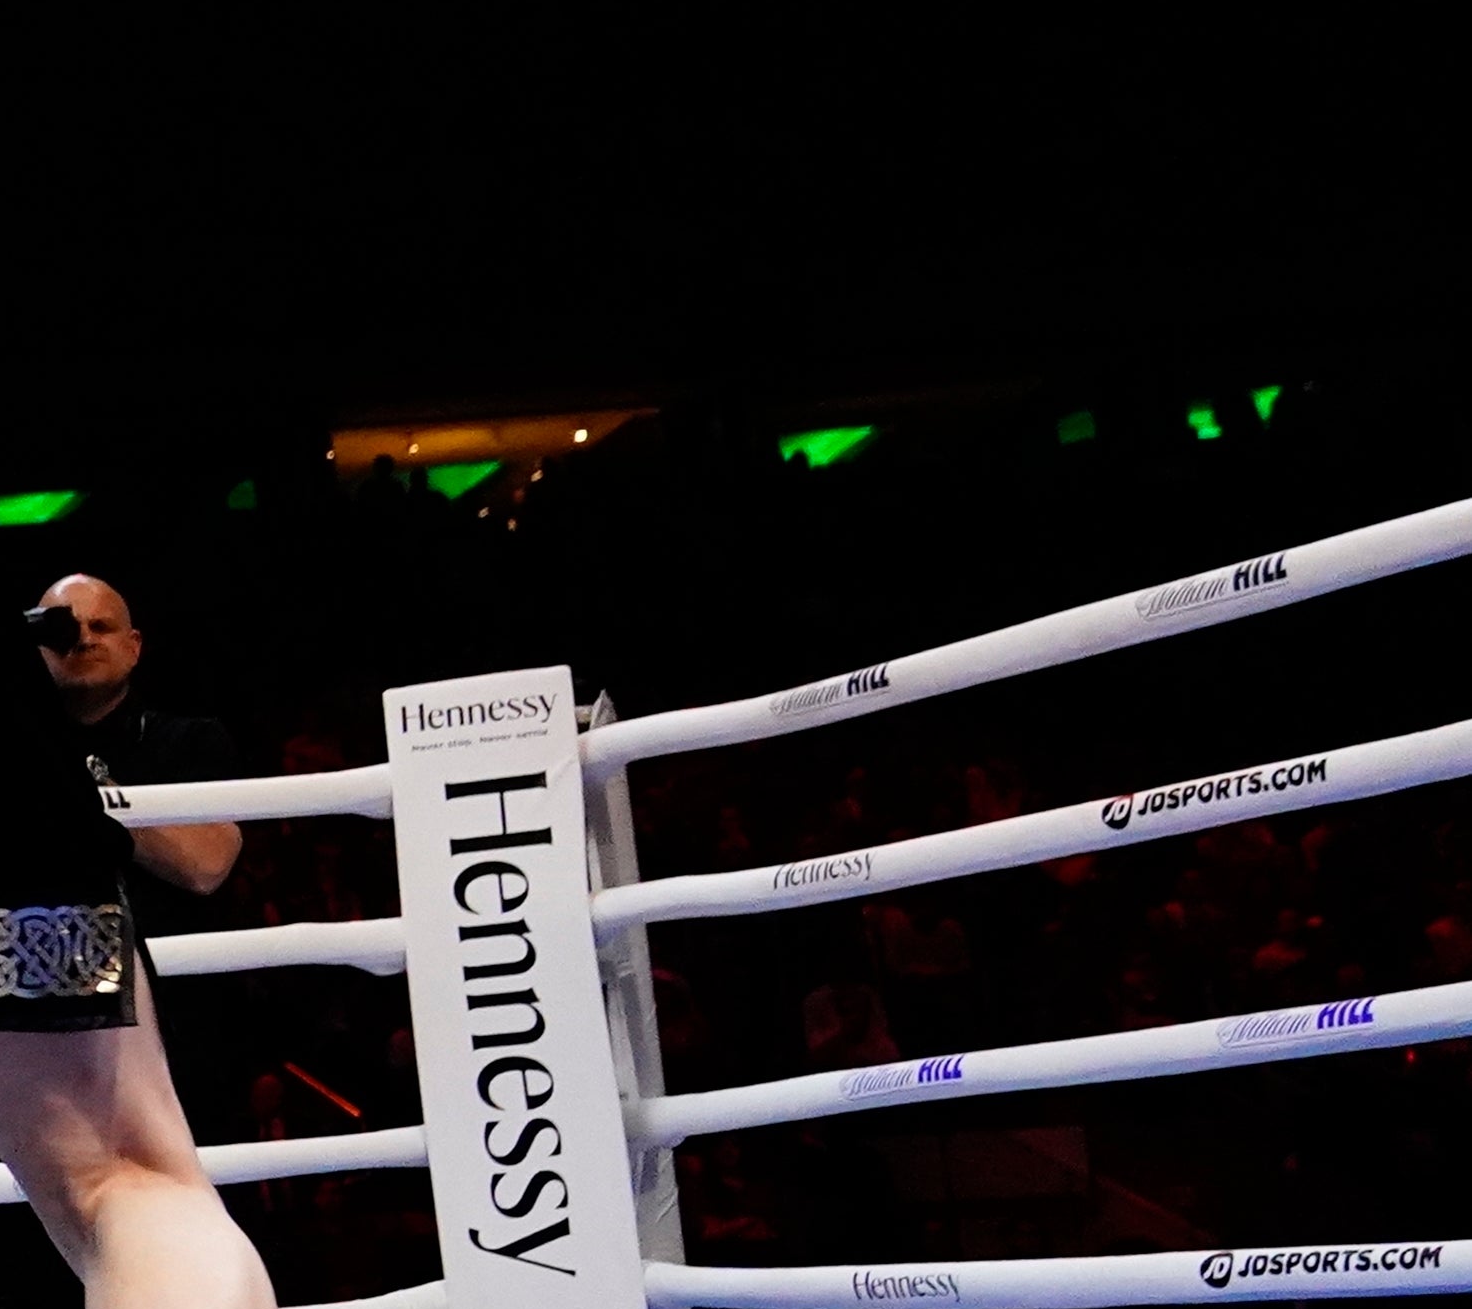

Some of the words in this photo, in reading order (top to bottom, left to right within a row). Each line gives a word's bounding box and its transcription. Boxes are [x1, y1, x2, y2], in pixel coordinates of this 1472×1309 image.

[1232, 553, 1287, 591] HILL
[400, 692, 557, 734] Hennessy
[1137, 757, 1327, 818] JDSPORTS.COM
[444, 771, 577, 1279] Hennessy
[1316, 997, 1375, 1030] HILL
[917, 1052, 964, 1084] HILL
[1237, 1245, 1444, 1278] JDSPORTS.COM
[851, 1271, 961, 1304] Hennessy
